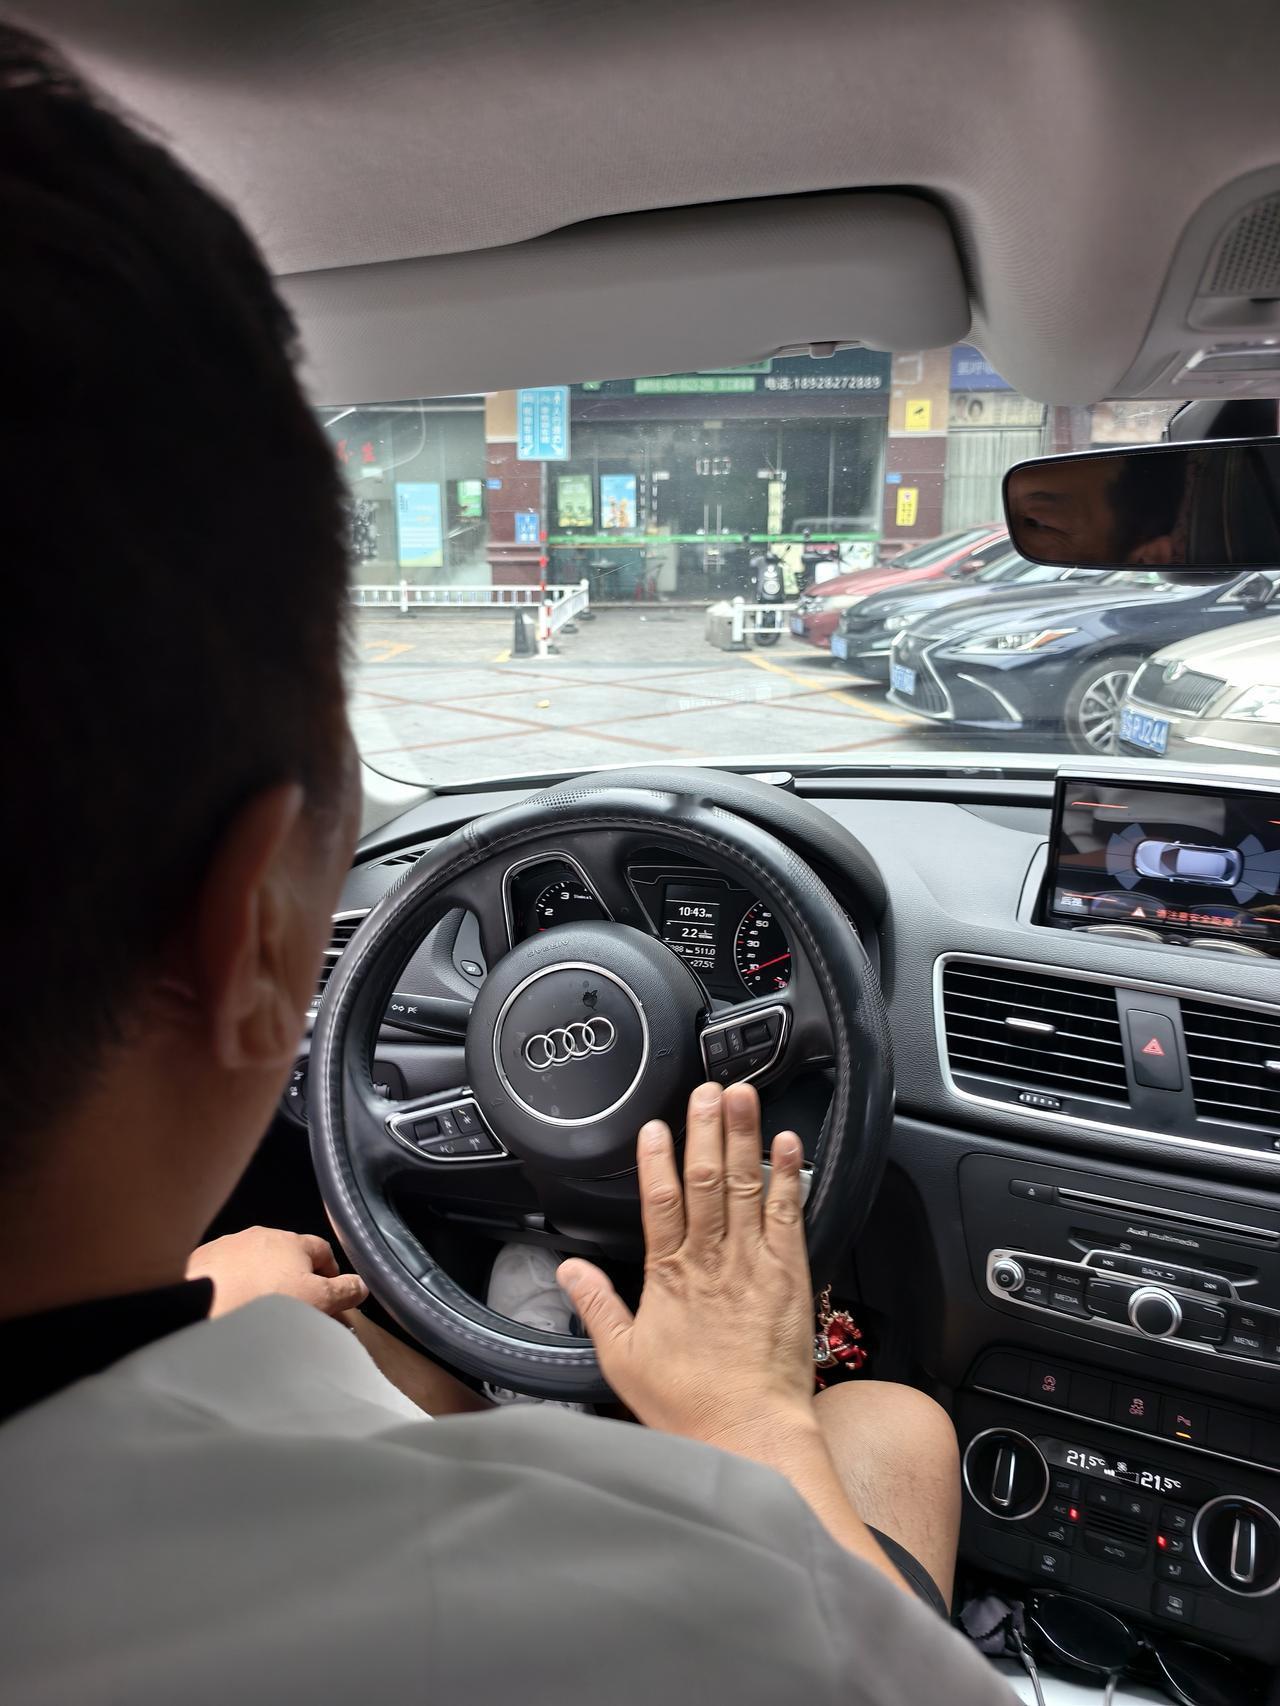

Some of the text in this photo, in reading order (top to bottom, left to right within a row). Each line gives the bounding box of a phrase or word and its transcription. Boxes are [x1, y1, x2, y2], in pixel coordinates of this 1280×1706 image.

[560, 892, 570, 900] 3
[544, 908, 554, 916] 2
[678, 906, 706, 918] 10:43
[755, 920, 769, 928] 50
[681, 927, 698, 939] 2.2
[746, 940, 760, 948] 30
[694, 946, 716, 955] 511.0
[1126, 1226, 1200, 1248] Audi multimedia
[1141, 1266, 1163, 1279] BACK
[1056, 1273, 1081, 1285] RADIO
[1024, 1285, 1042, 1296] CAR
[1053, 1292, 1079, 1305] MEDIA
[1232, 1335, 1260, 1348] MENU
[1041, 1384, 1056, 1393] OFF
[1052, 1505, 1066, 1514] A/C
